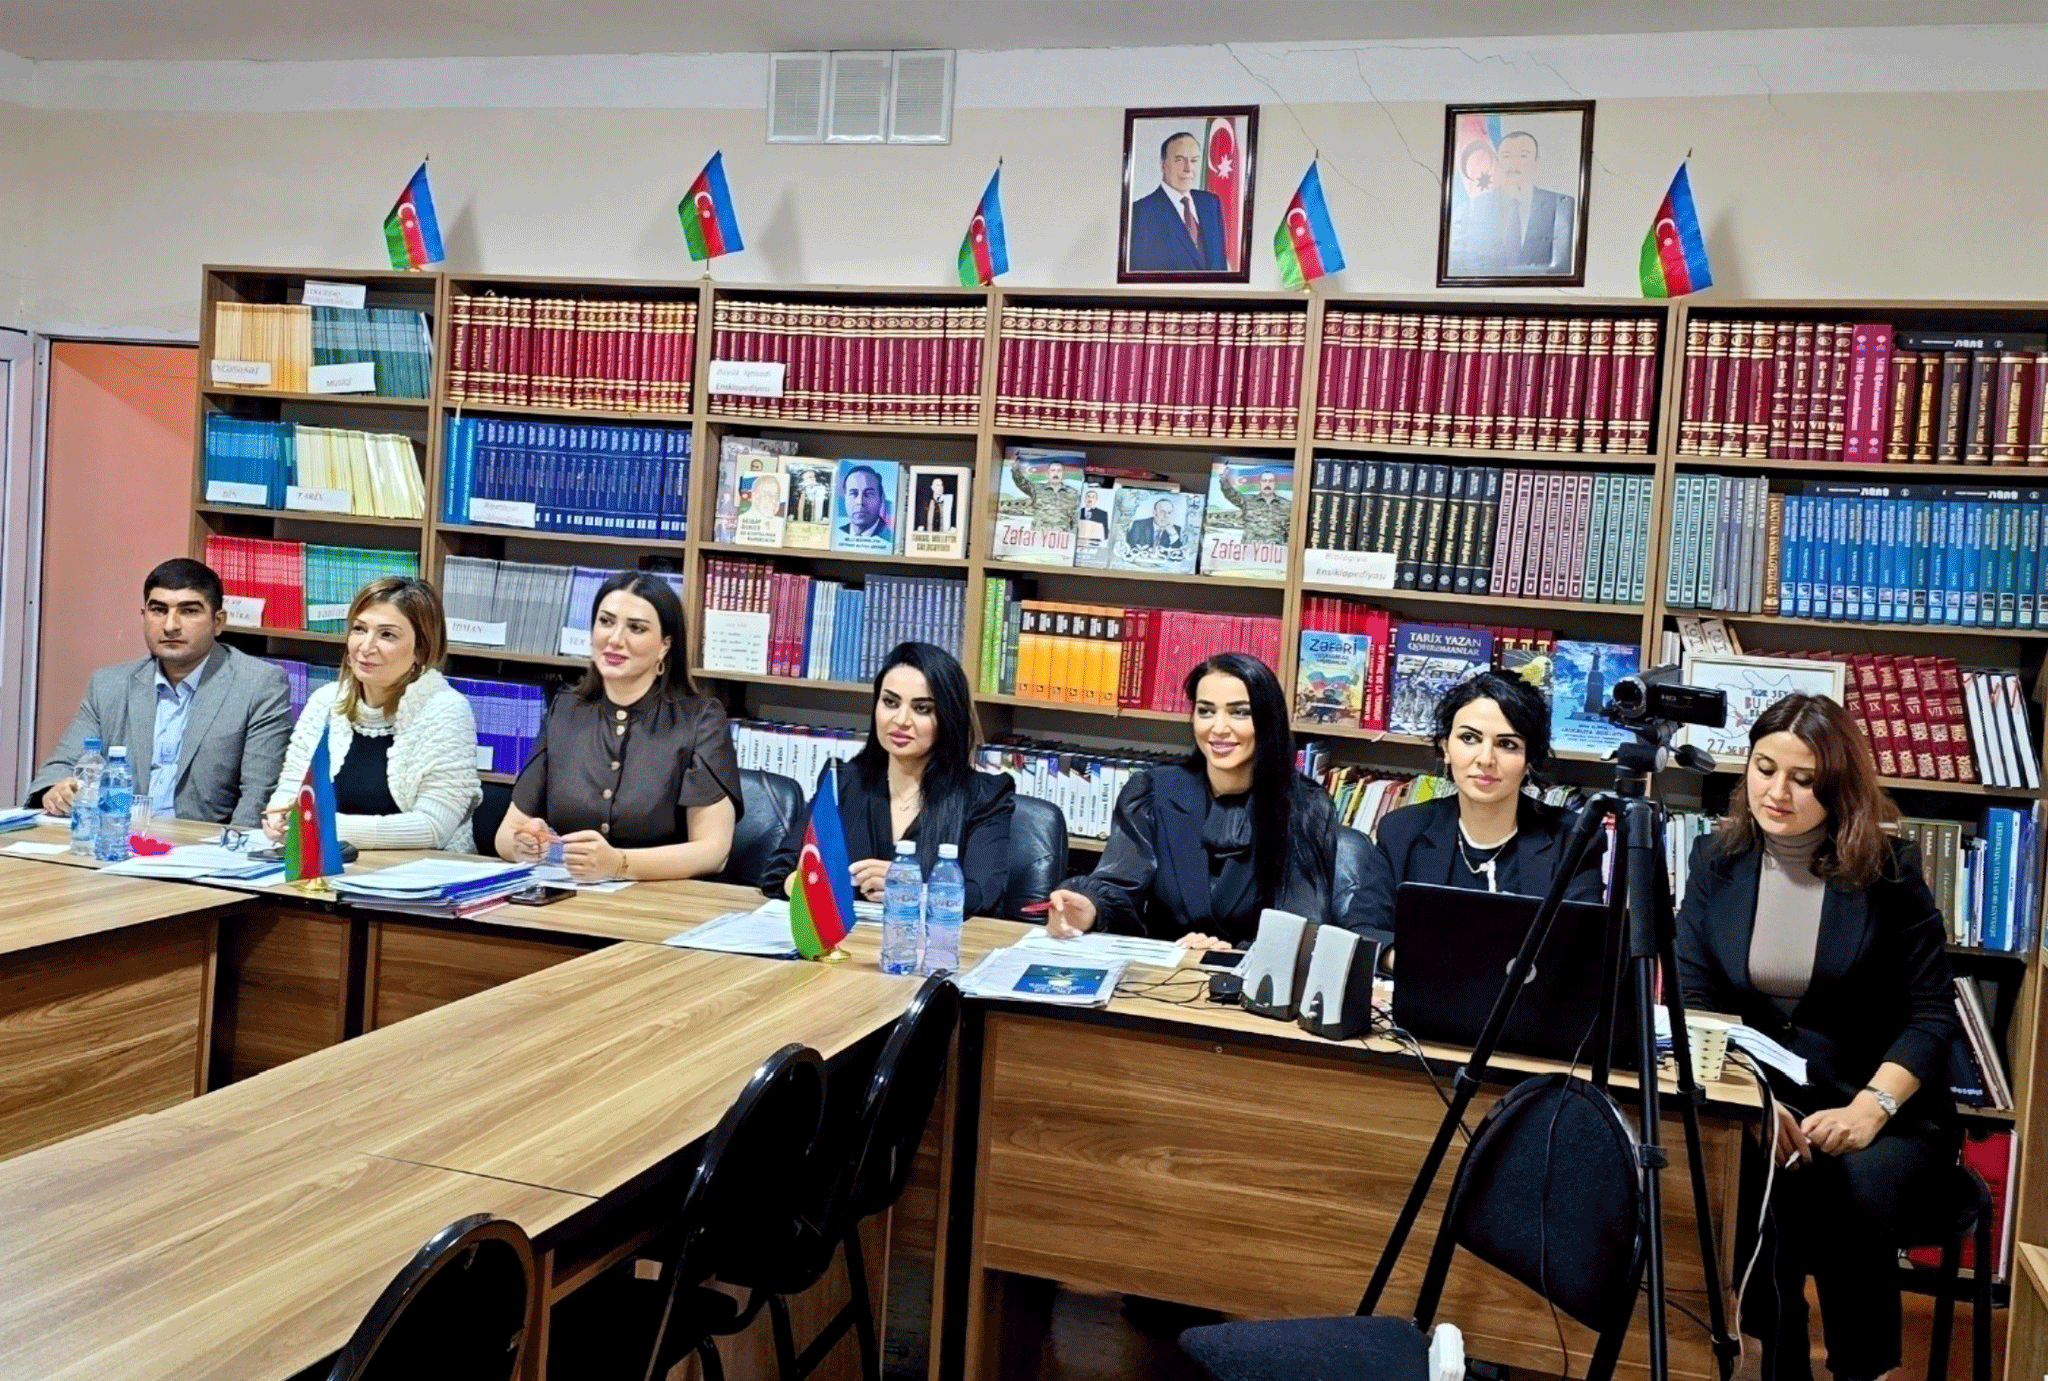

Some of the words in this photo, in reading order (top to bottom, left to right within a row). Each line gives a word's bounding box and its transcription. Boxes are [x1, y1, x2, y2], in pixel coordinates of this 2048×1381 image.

[1772, 419, 1786, 428] VI
[1792, 420, 1805, 429] VI
[1809, 420, 1826, 430] VII
[1828, 422, 1844, 432] VII
[1041, 527, 1069, 549] Yolu
[1252, 541, 1283, 563] Yolu
[1410, 631, 1443, 644] TARİX
[1445, 634, 1482, 647] YAZAN
[1707, 738, 1726, 754] 27
